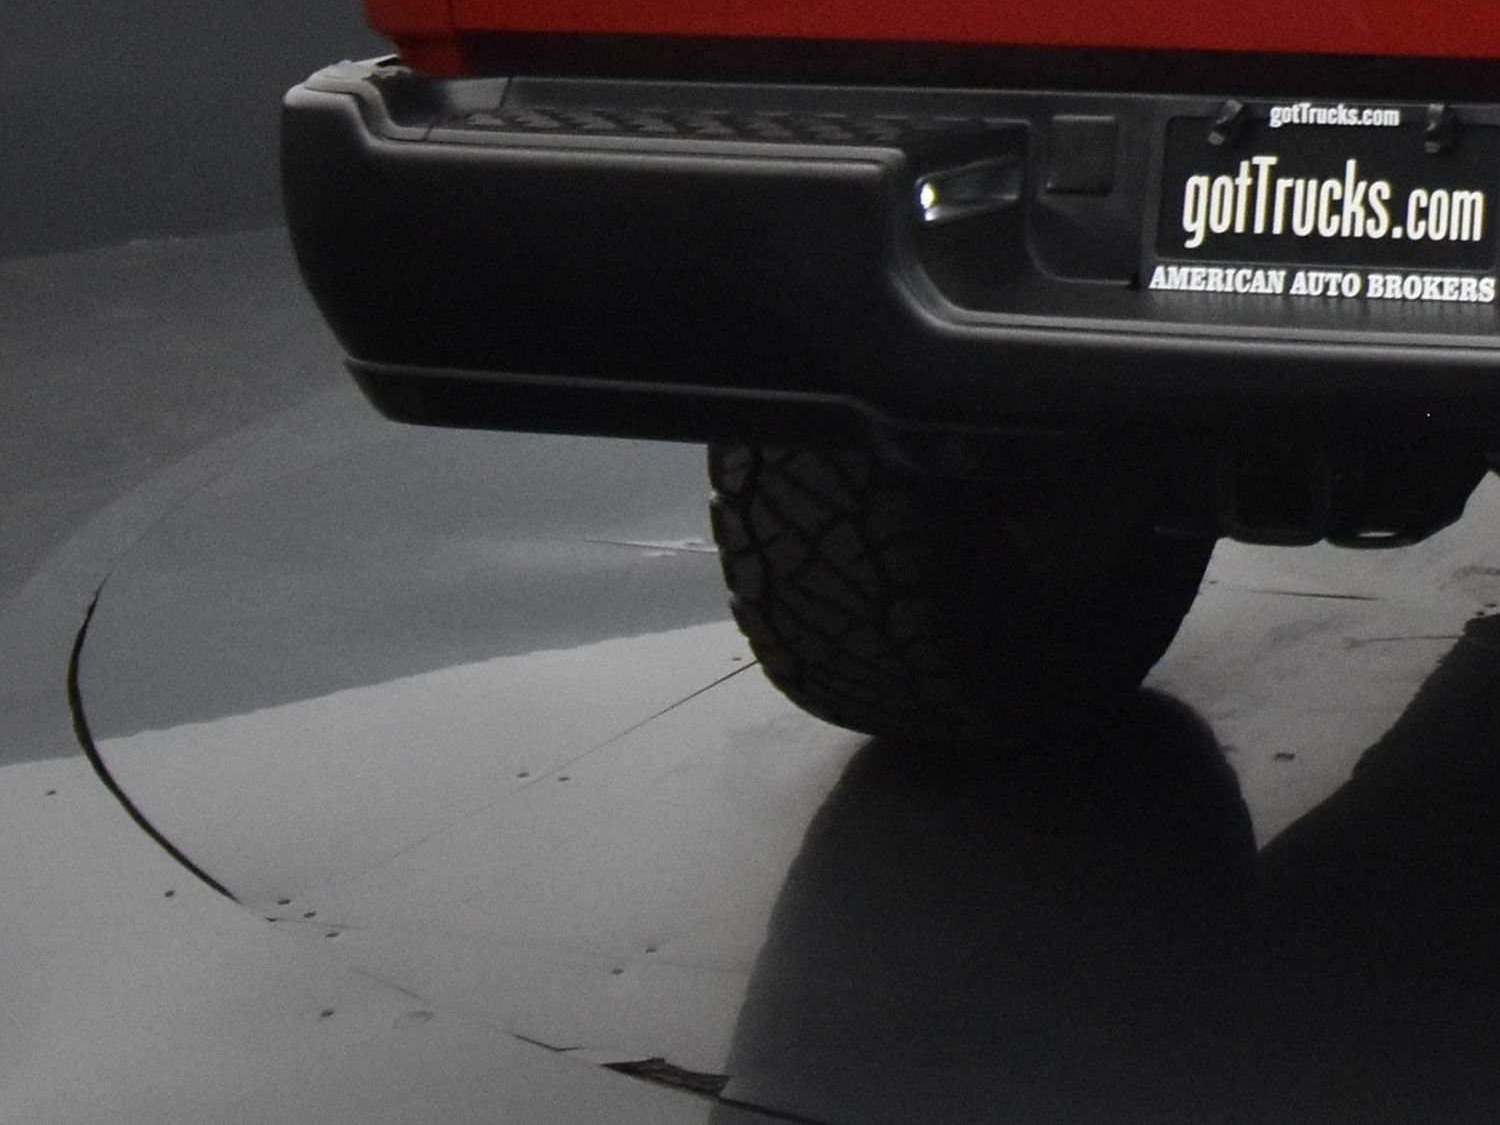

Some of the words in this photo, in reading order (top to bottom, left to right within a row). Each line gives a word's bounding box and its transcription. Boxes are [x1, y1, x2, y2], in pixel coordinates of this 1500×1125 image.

[1269, 103, 1400, 128] gotTrucks.com
[1182, 155, 1484, 249] gotTrucks.com
[1149, 266, 1286, 295] AMERICAN
[1290, 271, 1361, 298] AUTO
[1366, 276, 1497, 303] BROKERS
